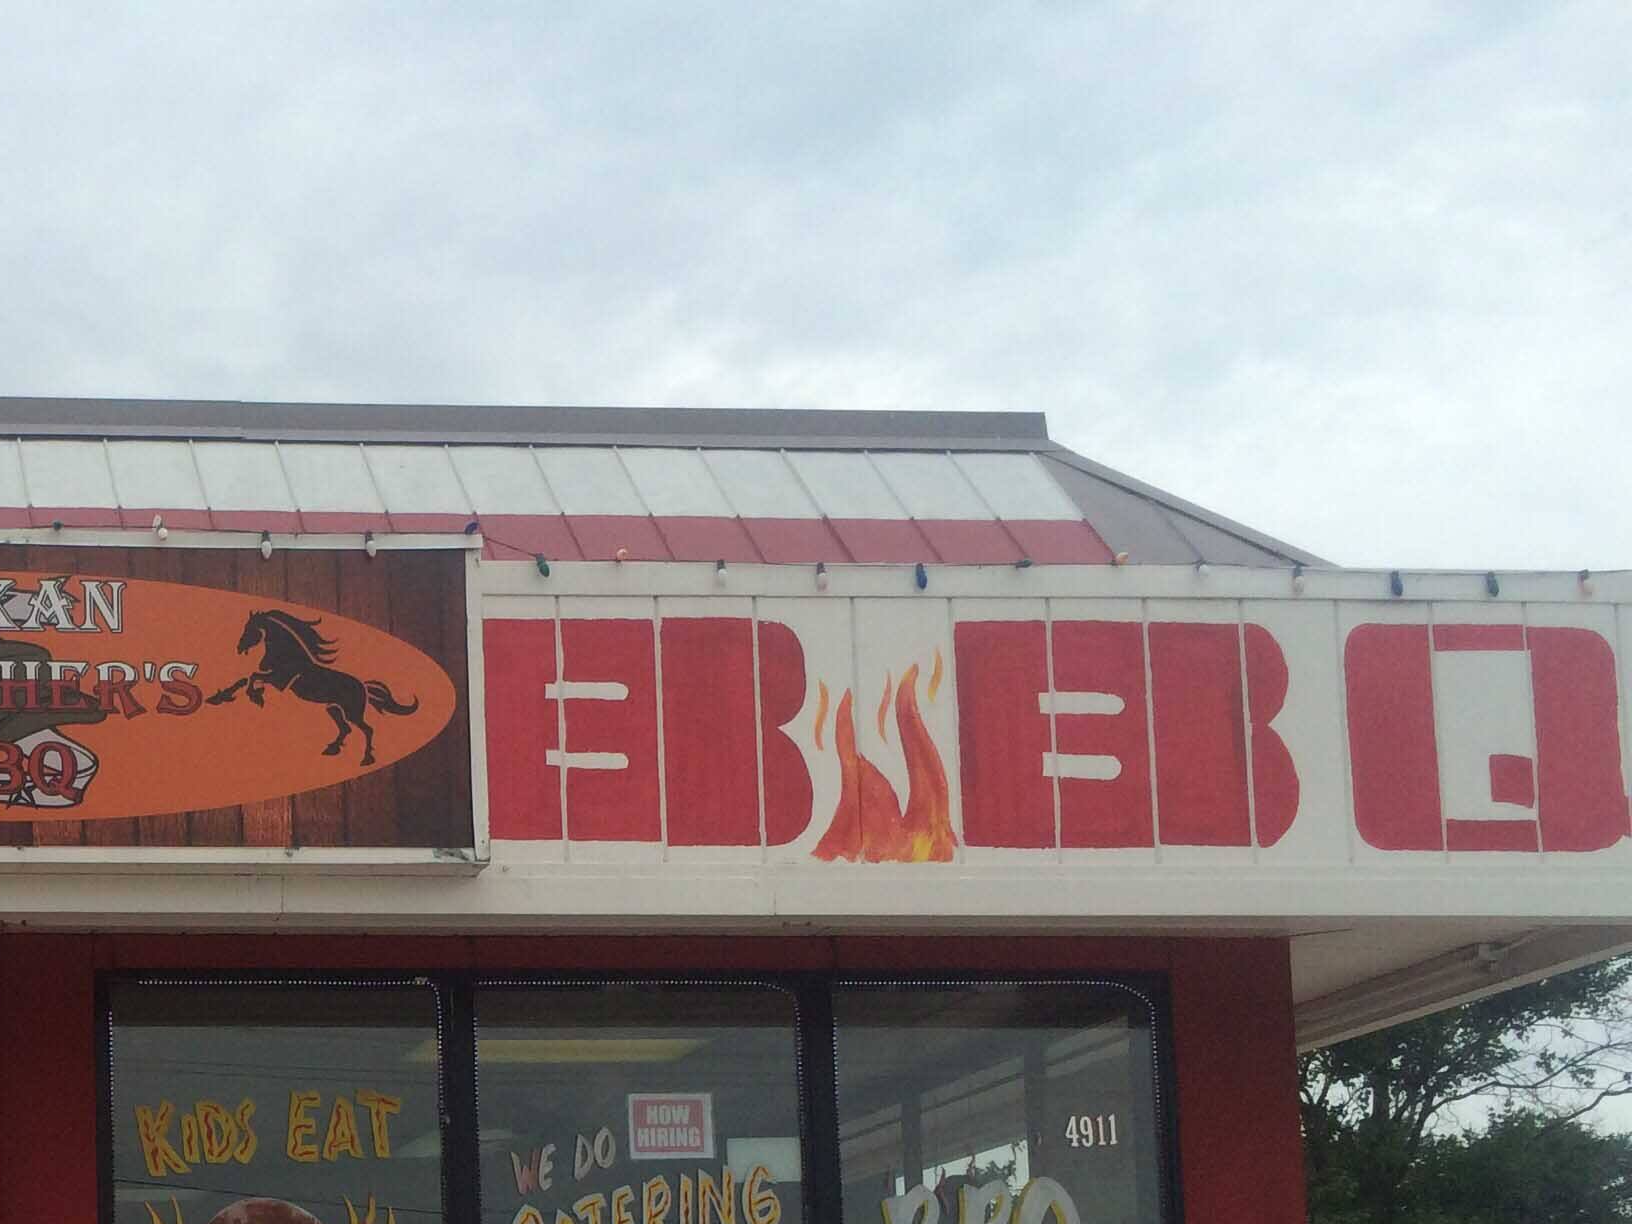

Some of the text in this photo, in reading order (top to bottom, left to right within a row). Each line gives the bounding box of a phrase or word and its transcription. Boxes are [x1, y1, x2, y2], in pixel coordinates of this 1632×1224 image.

[482, 616, 1632, 851] BBQ
[136, 1088, 401, 1177] KIDS EAT
[637, 1126, 701, 1148] HIRING
[646, 1103, 690, 1126] NOW
[1064, 1112, 1119, 1149] 4911
[510, 1126, 617, 1195] WE DO
